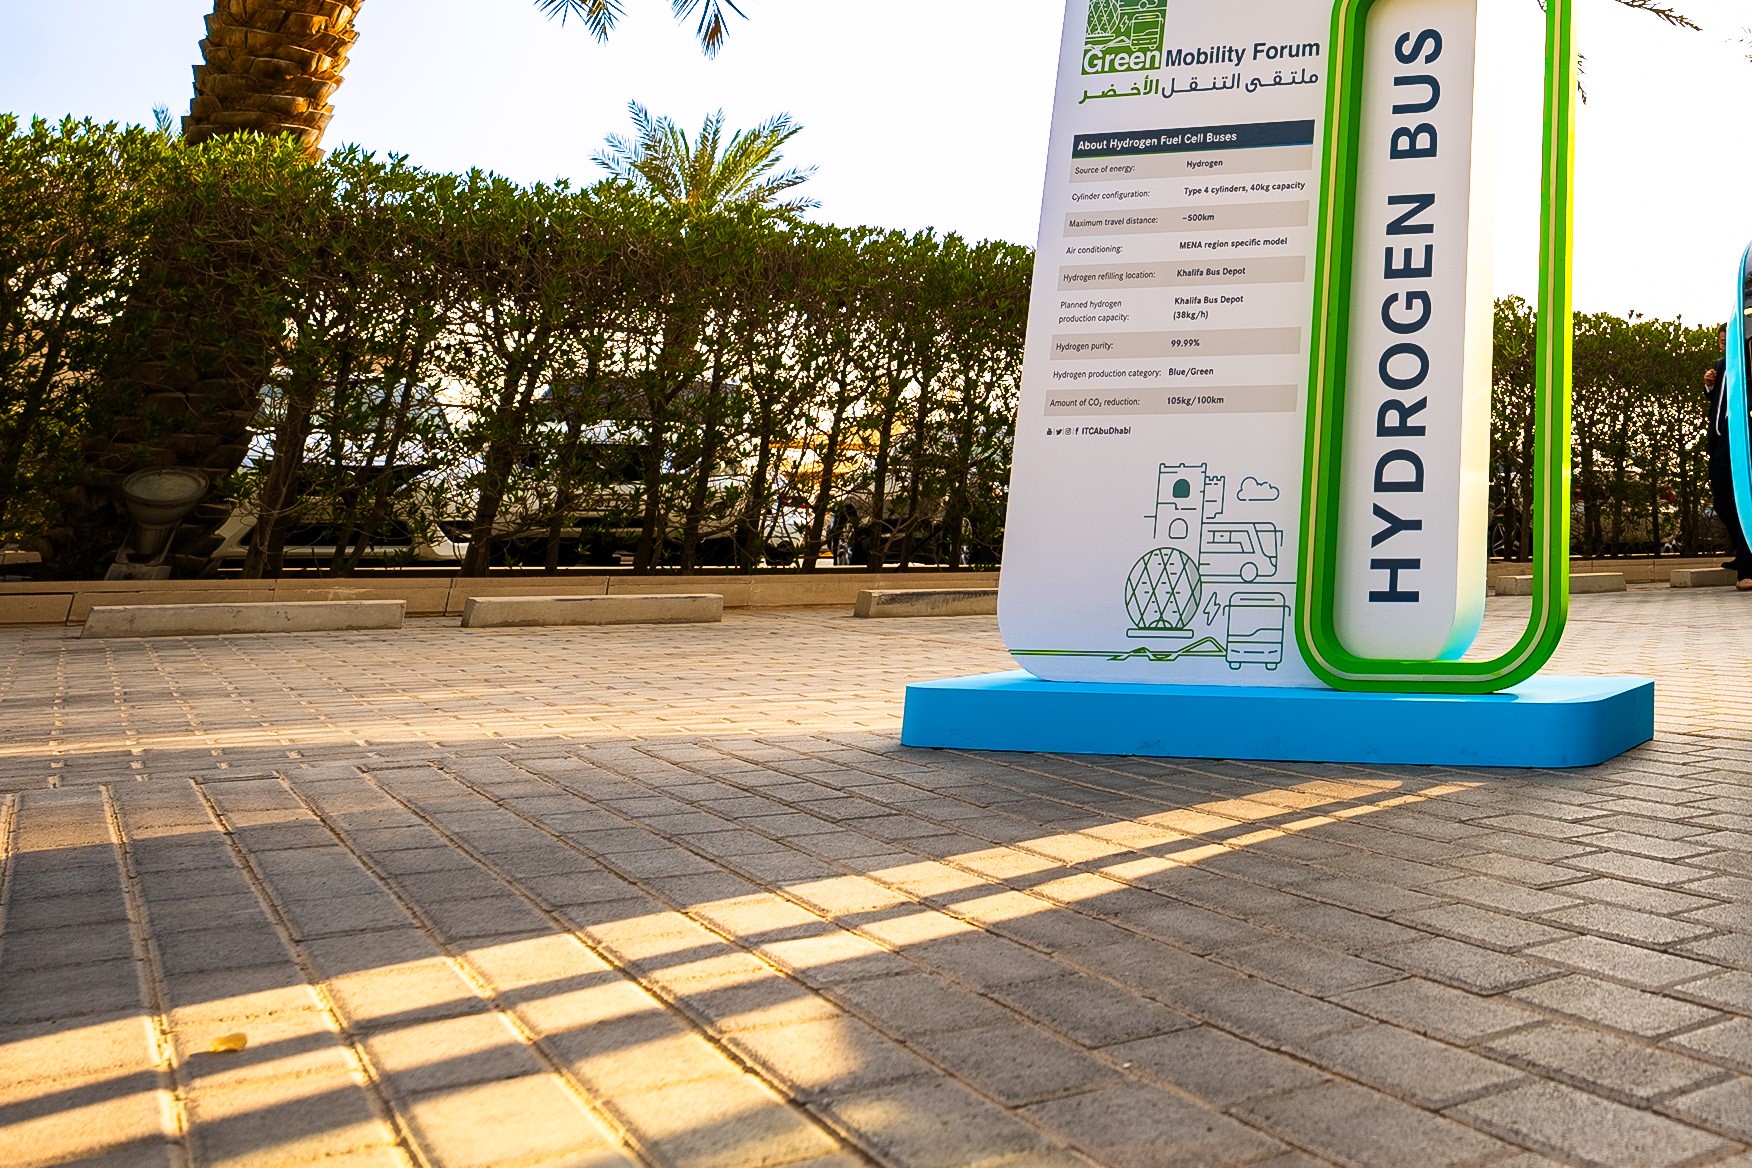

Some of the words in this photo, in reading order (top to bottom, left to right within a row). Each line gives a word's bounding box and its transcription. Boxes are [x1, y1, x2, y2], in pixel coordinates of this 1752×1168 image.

[1083, 50, 1160, 73] Green
[1165, 45, 1246, 68] Mobility
[1252, 42, 1321, 60] Forum
[1161, 73, 1241, 99] التنقل
[1245, 68, 1319, 93] ملتقى
[1078, 75, 1160, 104] الأخضر
[1390, 29, 1442, 160] BUS
[1077, 140, 1107, 150] About
[1109, 138, 1157, 151] Hydrogen
[1160, 135, 1181, 145] Fuel
[1184, 133, 1203, 144] Cell
[1206, 132, 1237, 142] Buses
[1075, 167, 1099, 175] Source
[1101, 165, 1108, 173] of
[1110, 165, 1135, 174] energy:
[1186, 160, 1223, 169] Hydrogen
[1184, 187, 1202, 197] Type
[1203, 186, 1209, 194] 4
[1211, 185, 1248, 195] cylinders,
[1250, 183, 1270, 192] 40kg
[1272, 181, 1306, 191] capacity
[1071, 192, 1100, 203] Cylinder
[1102, 190, 1151, 200] configuration:
[1069, 218, 1102, 227] Maximum
[1104, 217, 1124, 226] travel
[1125, 216, 1158, 225] distance:
[1182, 213, 1215, 222] ~500km
[1179, 241, 1202, 249] MENA
[1204, 240, 1229, 249] region
[1230, 238, 1261, 249] specific
[1262, 237, 1288, 246] model
[1077, 245, 1123, 254] conditioning:
[1063, 273, 1096, 283] Hydrogen
[1098, 271, 1124, 281] refilling
[1125, 270, 1156, 279] location:
[1176, 268, 1204, 277] Khalifa
[1206, 268, 1220, 276] Bus
[1222, 267, 1246, 277] Depot
[1060, 301, 1088, 309] Planned
[1089, 300, 1122, 309] hydrogen
[1174, 297, 1201, 305] Khalifa
[1203, 296, 1218, 304] Bus
[1220, 295, 1244, 305] Depot
[1058, 314, 1096, 324] production
[1097, 313, 1130, 323] capacity:
[1173, 310, 1209, 321] (38kg/h)
[1056, 342, 1089, 352] Hydrogen
[1091, 341, 1114, 351] purity:
[1171, 339, 1200, 347] 99.99%
[1053, 371, 1087, 380] Hydrogen
[1088, 369, 1127, 379] production
[1128, 369, 1162, 378] category:
[1168, 367, 1214, 377] Blue/Green
[1050, 399, 1077, 407] Amount
[1079, 398, 1087, 407] of
[1104, 397, 1140, 406] reduction:
[1167, 396, 1224, 406] 105kg/100km
[1369, 193, 1436, 603] HYDROGEN
[1082, 427, 1131, 435] ITCAbuDhabi
